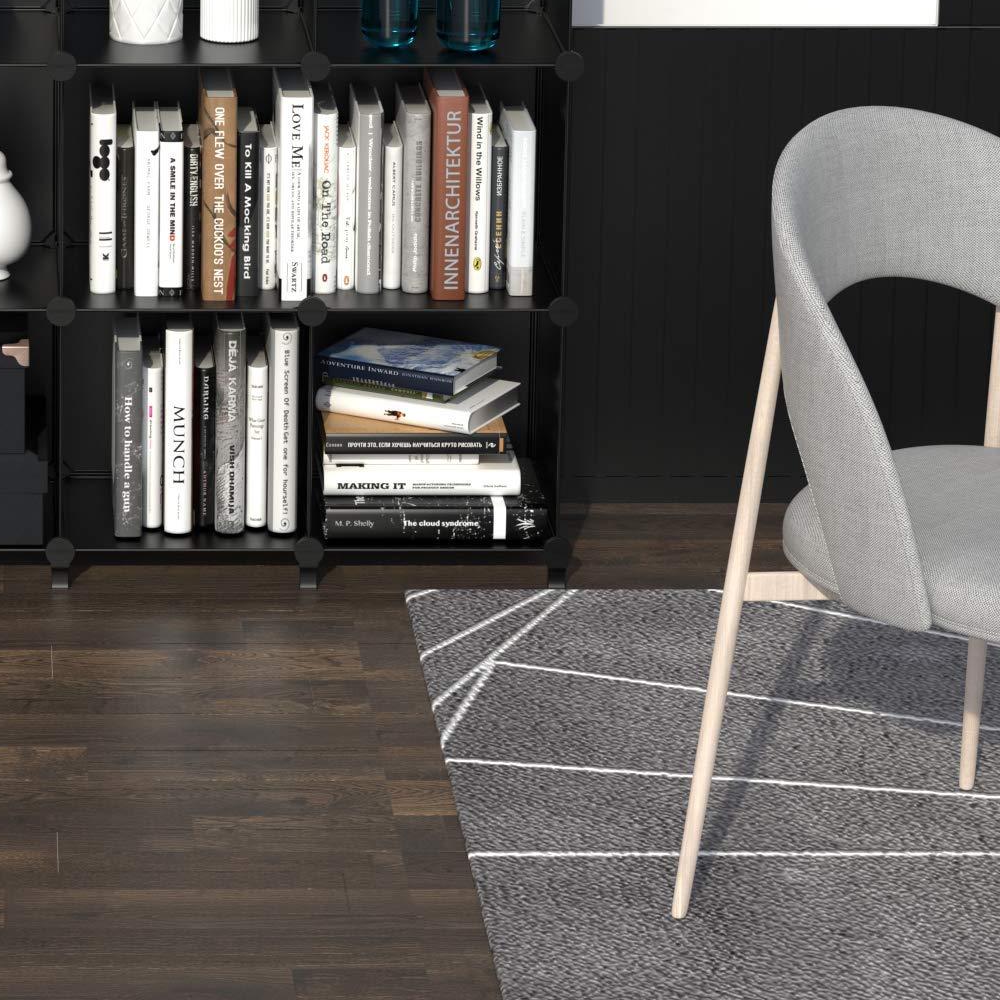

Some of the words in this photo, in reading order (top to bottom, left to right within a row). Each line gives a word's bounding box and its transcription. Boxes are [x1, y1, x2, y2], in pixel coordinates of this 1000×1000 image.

[213, 107, 225, 126] ONE
[291, 104, 304, 141] LOVE
[476, 116, 484, 140] Wind
[213, 130, 225, 159] FLEW
[244, 143, 252, 157] To
[291, 145, 304, 168] ME
[476, 141, 483, 150] in
[213, 163, 225, 190] OVER
[244, 161, 252, 179] Kill
[169, 192, 176, 201] IN
[244, 183, 251, 193] A
[321, 180, 331, 200] On
[475, 168, 483, 201] Willows
[213, 194, 225, 213] THE
[444, 111, 461, 290] INNENARCHITEKTUR
[242, 196, 251, 251] Mocking
[321, 202, 331, 229] The
[213, 217, 225, 265] CUCKOO'S
[321, 232, 331, 264] Road
[243, 255, 251, 280] Bird
[291, 261, 299, 293] SWARTZ
[213, 268, 225, 295] NEST
[320, 359, 366, 371] ADVENTURE
[367, 365, 399, 376] INWARD
[124, 396, 132, 424] How
[228, 378, 236, 422] KARMA
[284, 397, 290, 406] Of
[124, 426, 132, 438] to
[173, 405, 185, 484] MUNCH
[123, 439, 132, 479] handle
[337, 482, 391, 490] MAKING
[393, 482, 406, 490] IT
[120, 490, 131, 513] gun
[354, 520, 374, 528] Shelly
[419, 519, 440, 527] cloud
[442, 520, 479, 528] syndrome
